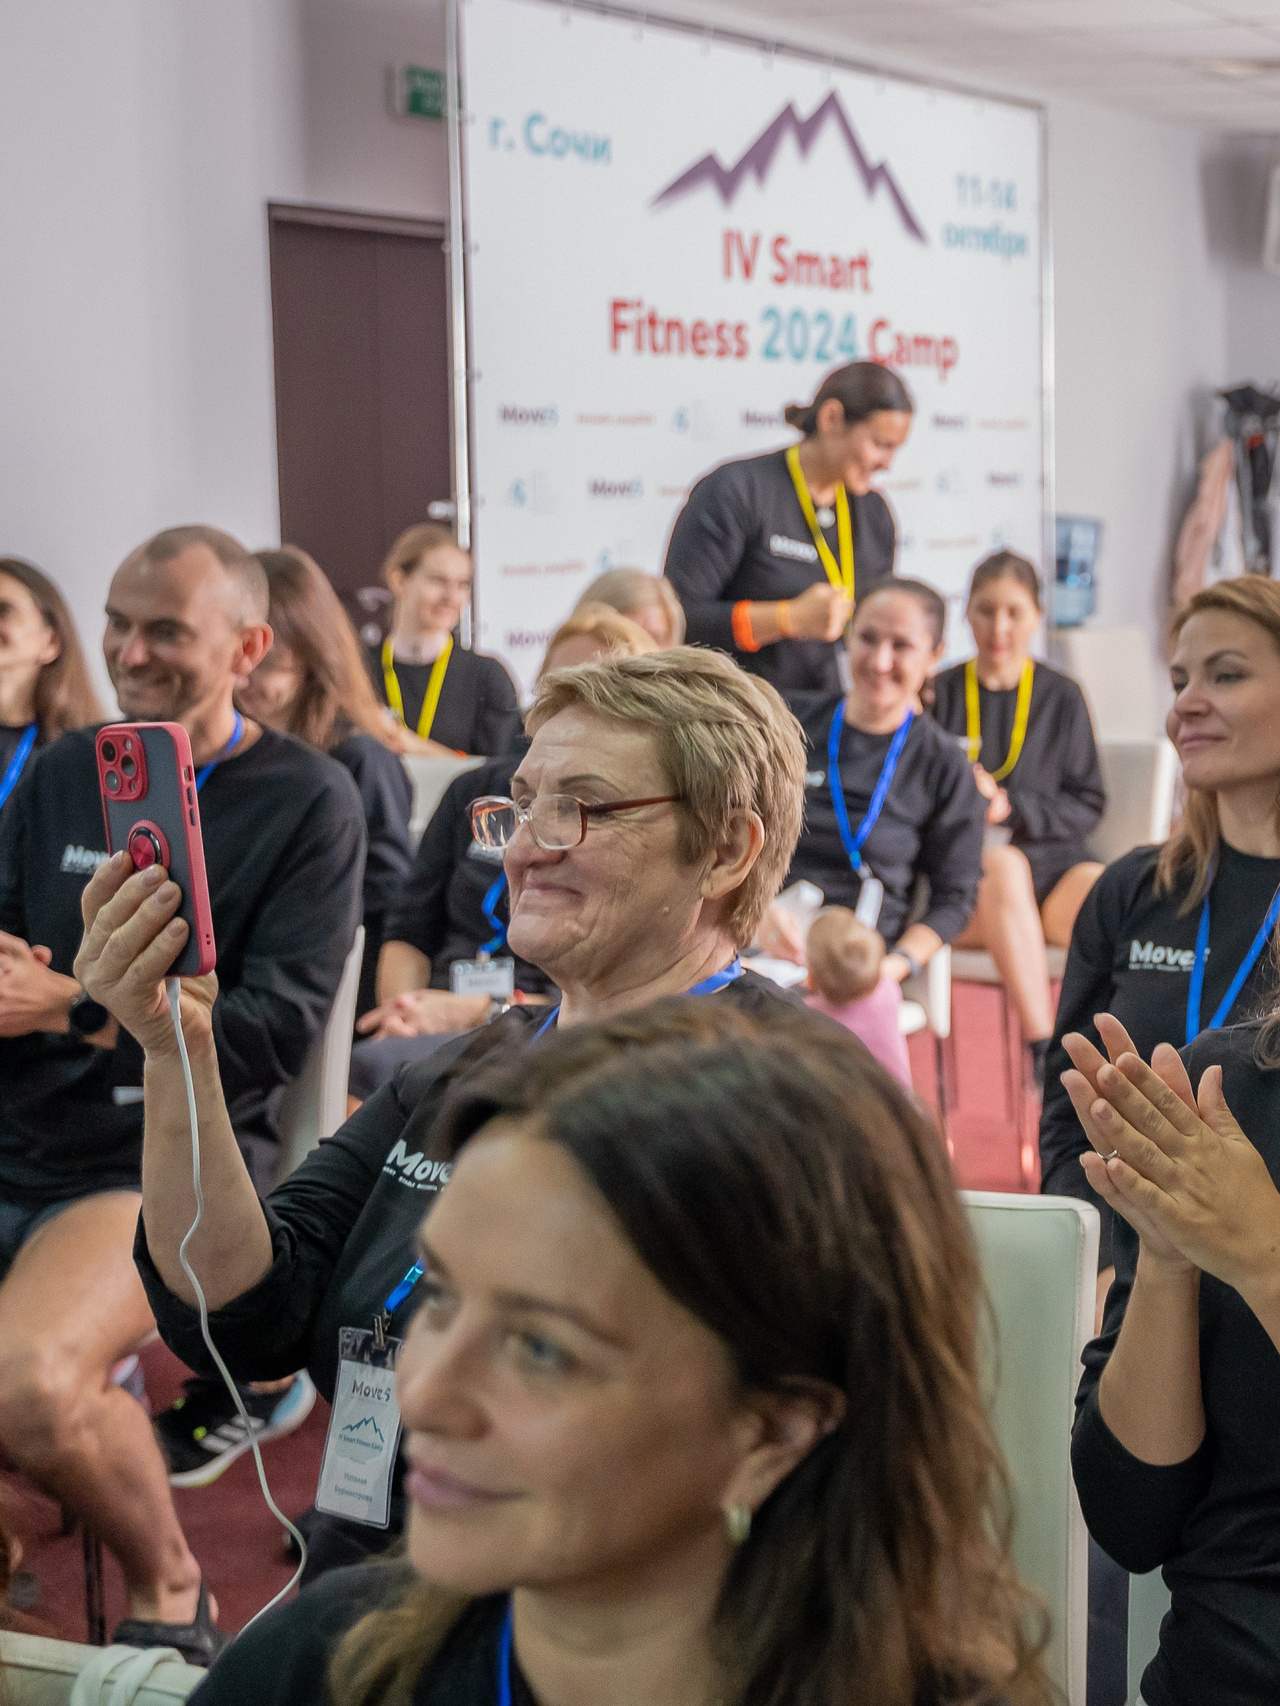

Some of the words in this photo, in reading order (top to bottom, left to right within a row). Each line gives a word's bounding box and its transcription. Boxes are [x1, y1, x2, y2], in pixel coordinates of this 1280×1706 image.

[488, 117, 514, 151] г.
[524, 112, 612, 163] Сочи
[722, 228, 760, 281] IV
[770, 233, 871, 292] Smart
[609, 298, 750, 360] Fitness
[760, 306, 858, 363] 2024
[866, 317, 960, 382] Camp
[1130, 940, 1211, 966] Move
